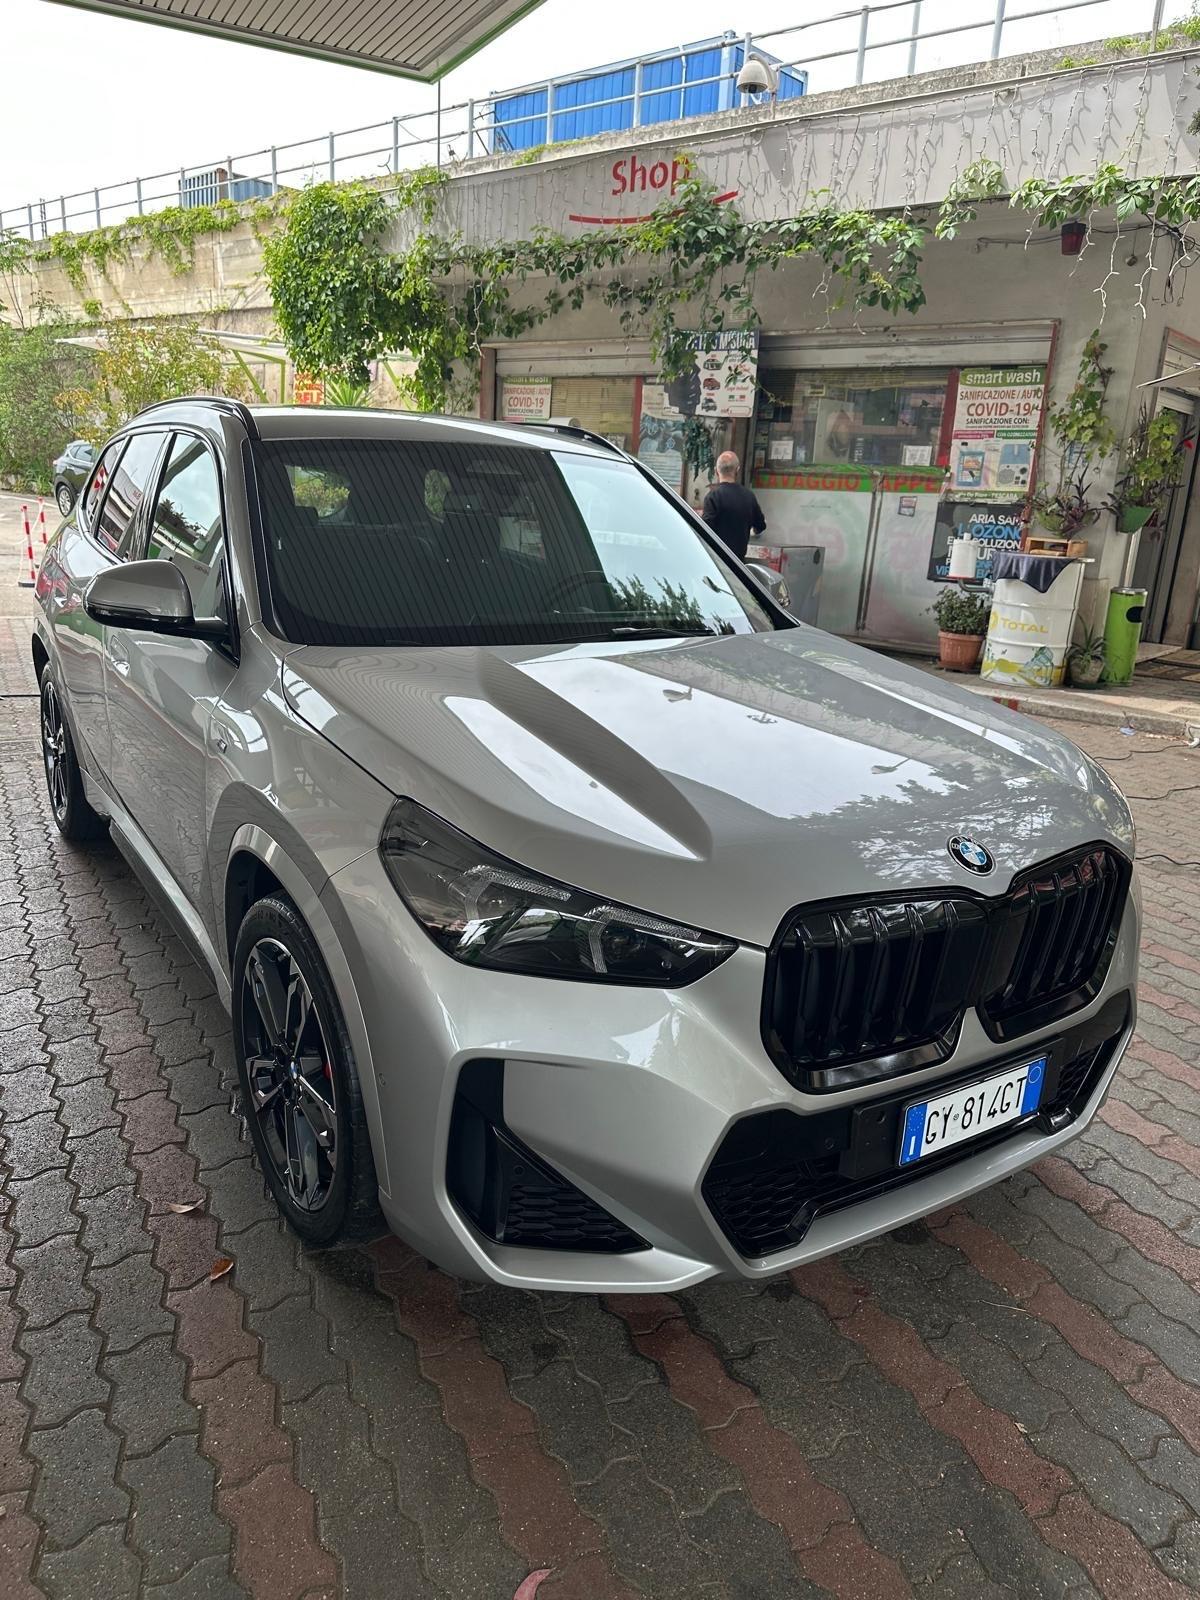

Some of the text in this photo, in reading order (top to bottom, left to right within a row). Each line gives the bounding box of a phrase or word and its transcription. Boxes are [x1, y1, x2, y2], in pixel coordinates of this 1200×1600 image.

[612, 156, 690, 196] Shop
[966, 369, 1040, 384] smart wash
[960, 389, 1016, 400] SANIFICAZIONE
[1021, 388, 1043, 399] AUTO
[508, 396, 545, 408] COVID-19
[966, 402, 1030, 417] COVID-19
[755, 472, 860, 491] LAVAGGIO
[969, 514, 996, 524] ARIA
[1001, 617, 1048, 633] TOTAL
[962, 1076, 1027, 1129] 814GT
